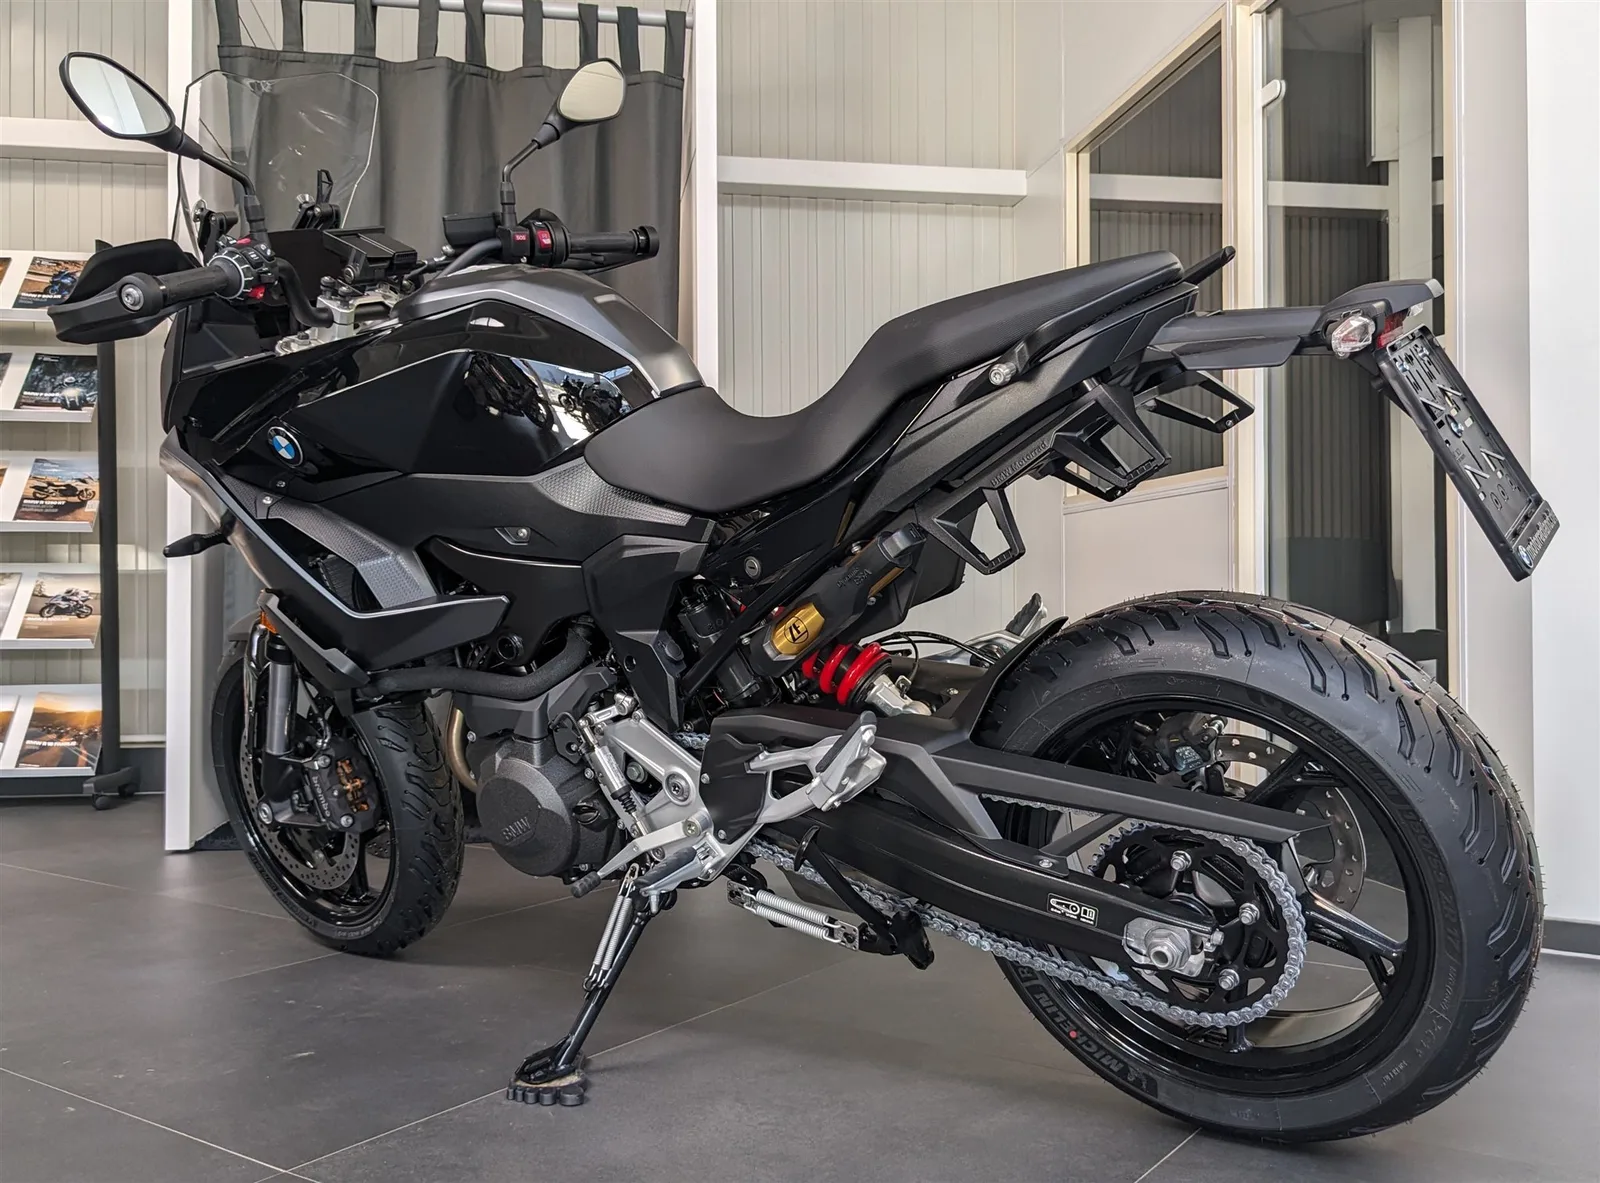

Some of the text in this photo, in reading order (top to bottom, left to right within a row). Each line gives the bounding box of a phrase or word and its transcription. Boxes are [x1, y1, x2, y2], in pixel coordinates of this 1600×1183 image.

[990, 440, 1049, 487] BMW Motorrad
[788, 622, 808, 642] ZF
[1285, 706, 1400, 799] MICHELIN
[312, 775, 331, 817] brembo
[502, 816, 531, 841] BMW
[1033, 992, 1125, 1073] MICHELIN
